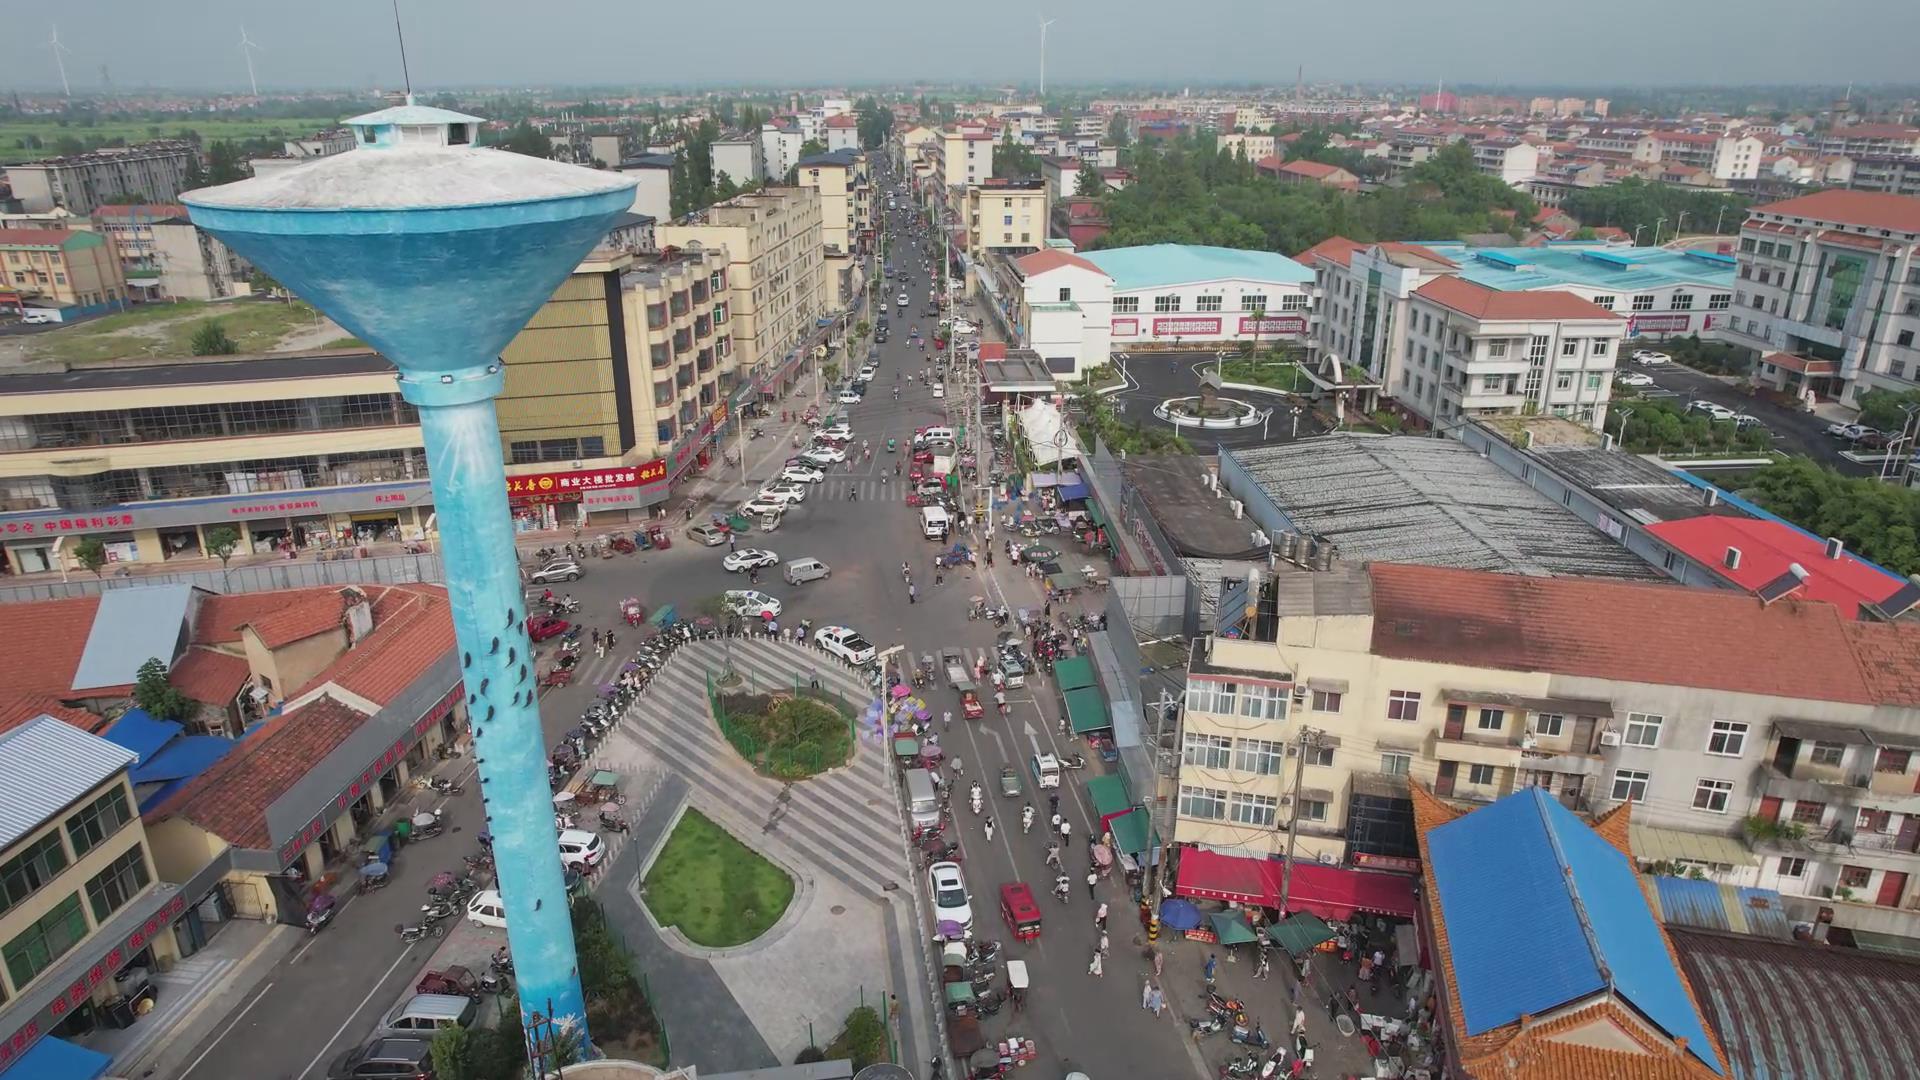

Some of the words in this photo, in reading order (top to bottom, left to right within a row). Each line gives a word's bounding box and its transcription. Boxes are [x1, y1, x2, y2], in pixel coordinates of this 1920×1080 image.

[560, 473, 635, 487] 商业大楼批发部
[43, 514, 134, 532] 中国福利彩票
